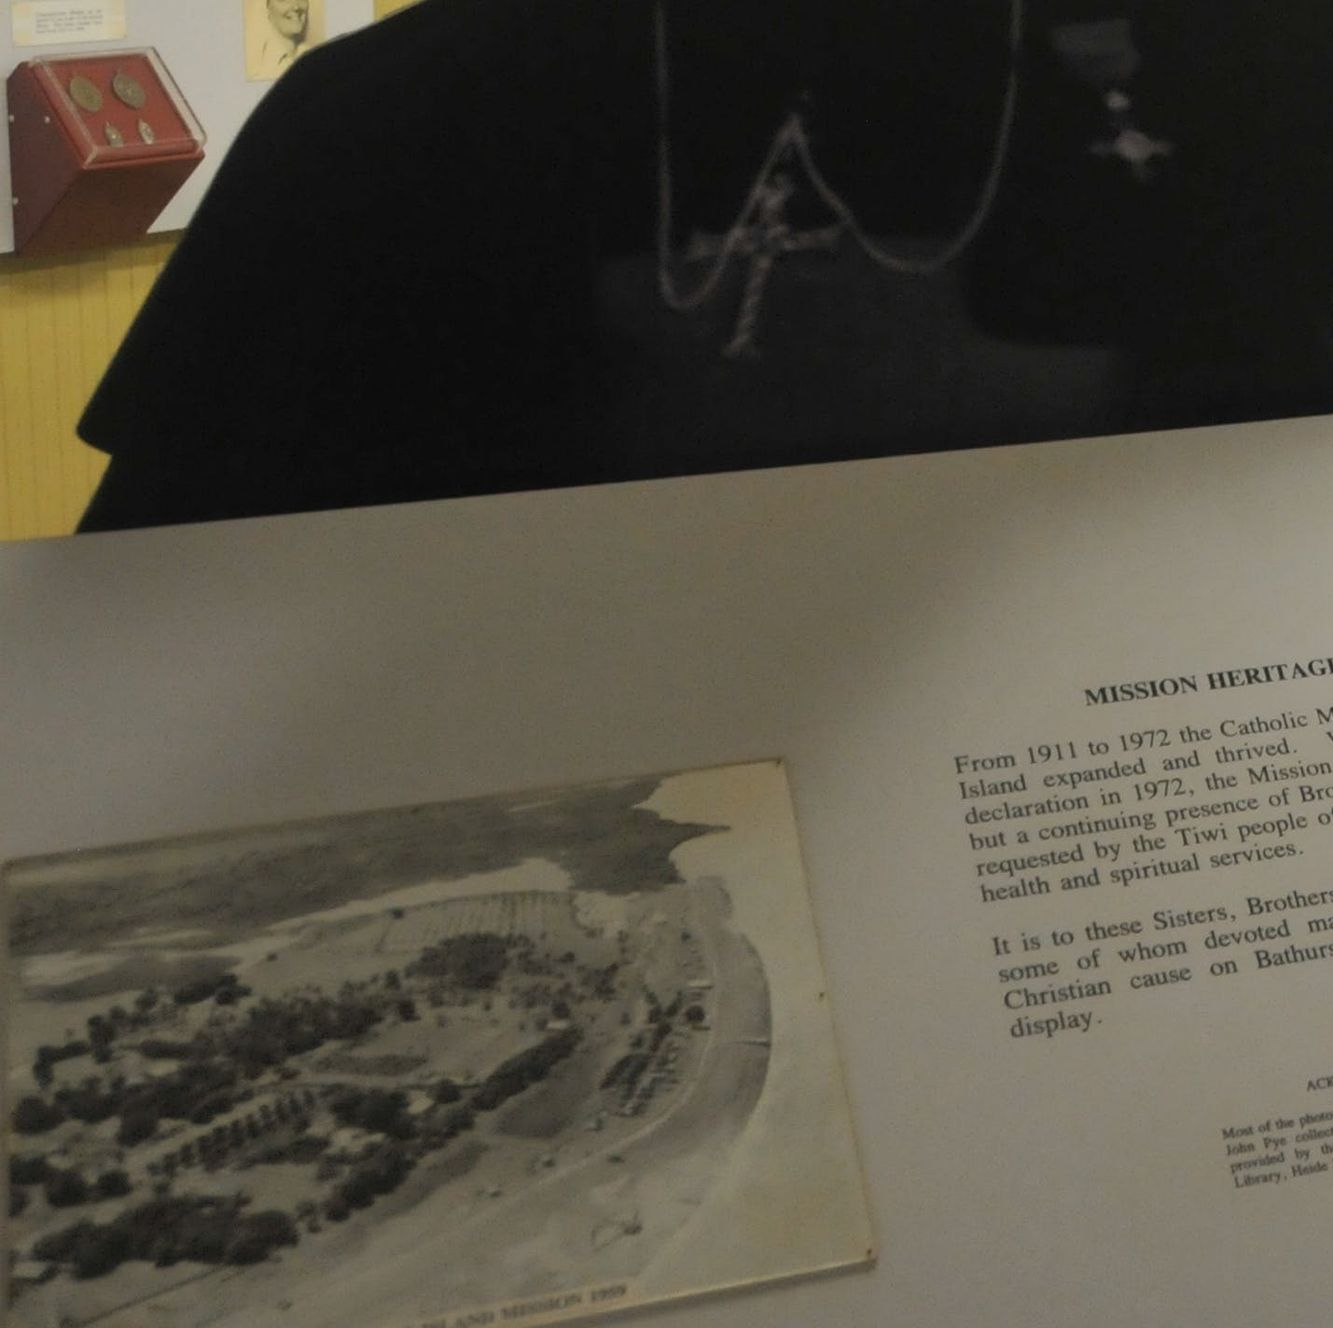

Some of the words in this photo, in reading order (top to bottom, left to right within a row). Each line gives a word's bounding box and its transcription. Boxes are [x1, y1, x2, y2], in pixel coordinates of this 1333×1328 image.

[1083, 674, 1199, 707] MISSION
[953, 754, 1018, 775] From
[1027, 740, 1078, 765] 1911
[1087, 741, 1110, 757] to
[1119, 728, 1172, 753] 1972
[1178, 724, 1213, 744] the
[1219, 711, 1309, 738] Catholic
[958, 772, 1029, 800] Island
[1042, 756, 1148, 789] expanded
[1161, 748, 1202, 772] and
[1214, 736, 1298, 765] thrived.
[964, 793, 1091, 826] declaration
[1099, 787, 1123, 807] in
[1132, 776, 1195, 802] 1972,
[1204, 771, 1239, 792] the
[1245, 759, 1333, 786] Mission
[968, 831, 1008, 851] but
[1016, 830, 1031, 845] a
[1037, 810, 1158, 841] continuing
[1163, 797, 1261, 827] presence
[1267, 786, 1291, 808] of
[975, 842, 1086, 878] requested
[1092, 840, 1122, 862] by
[1131, 833, 1167, 854] the
[1173, 821, 1229, 847] Tiwi
[1236, 811, 1309, 843] people
[979, 875, 1052, 904] health
[1059, 866, 1102, 892] and
[1109, 851, 1201, 888] spiritual
[1209, 842, 1304, 869] services.
[991, 935, 1012, 957] It
[1020, 931, 1042, 952] is
[1050, 930, 1075, 947] to
[1084, 920, 1144, 942] these
[1152, 906, 1237, 931] Sisters,
[997, 961, 1060, 984] some
[1076, 947, 1101, 971] of
[1116, 940, 1189, 963] whom
[1203, 918, 1292, 950] devoted
[1003, 978, 1113, 1011] Christian
[1129, 967, 1193, 990] cause
[1209, 959, 1239, 977] on
[1009, 1009, 1103, 1039] display.
[1220, 1124, 1256, 1141] Most
[1256, 1118, 1274, 1135] of
[1273, 1116, 1297, 1132] the
[1225, 1141, 1258, 1158] John
[1261, 1135, 1289, 1151] Pye
[1228, 1148, 1287, 1174] provided
[1293, 1147, 1311, 1161] by
